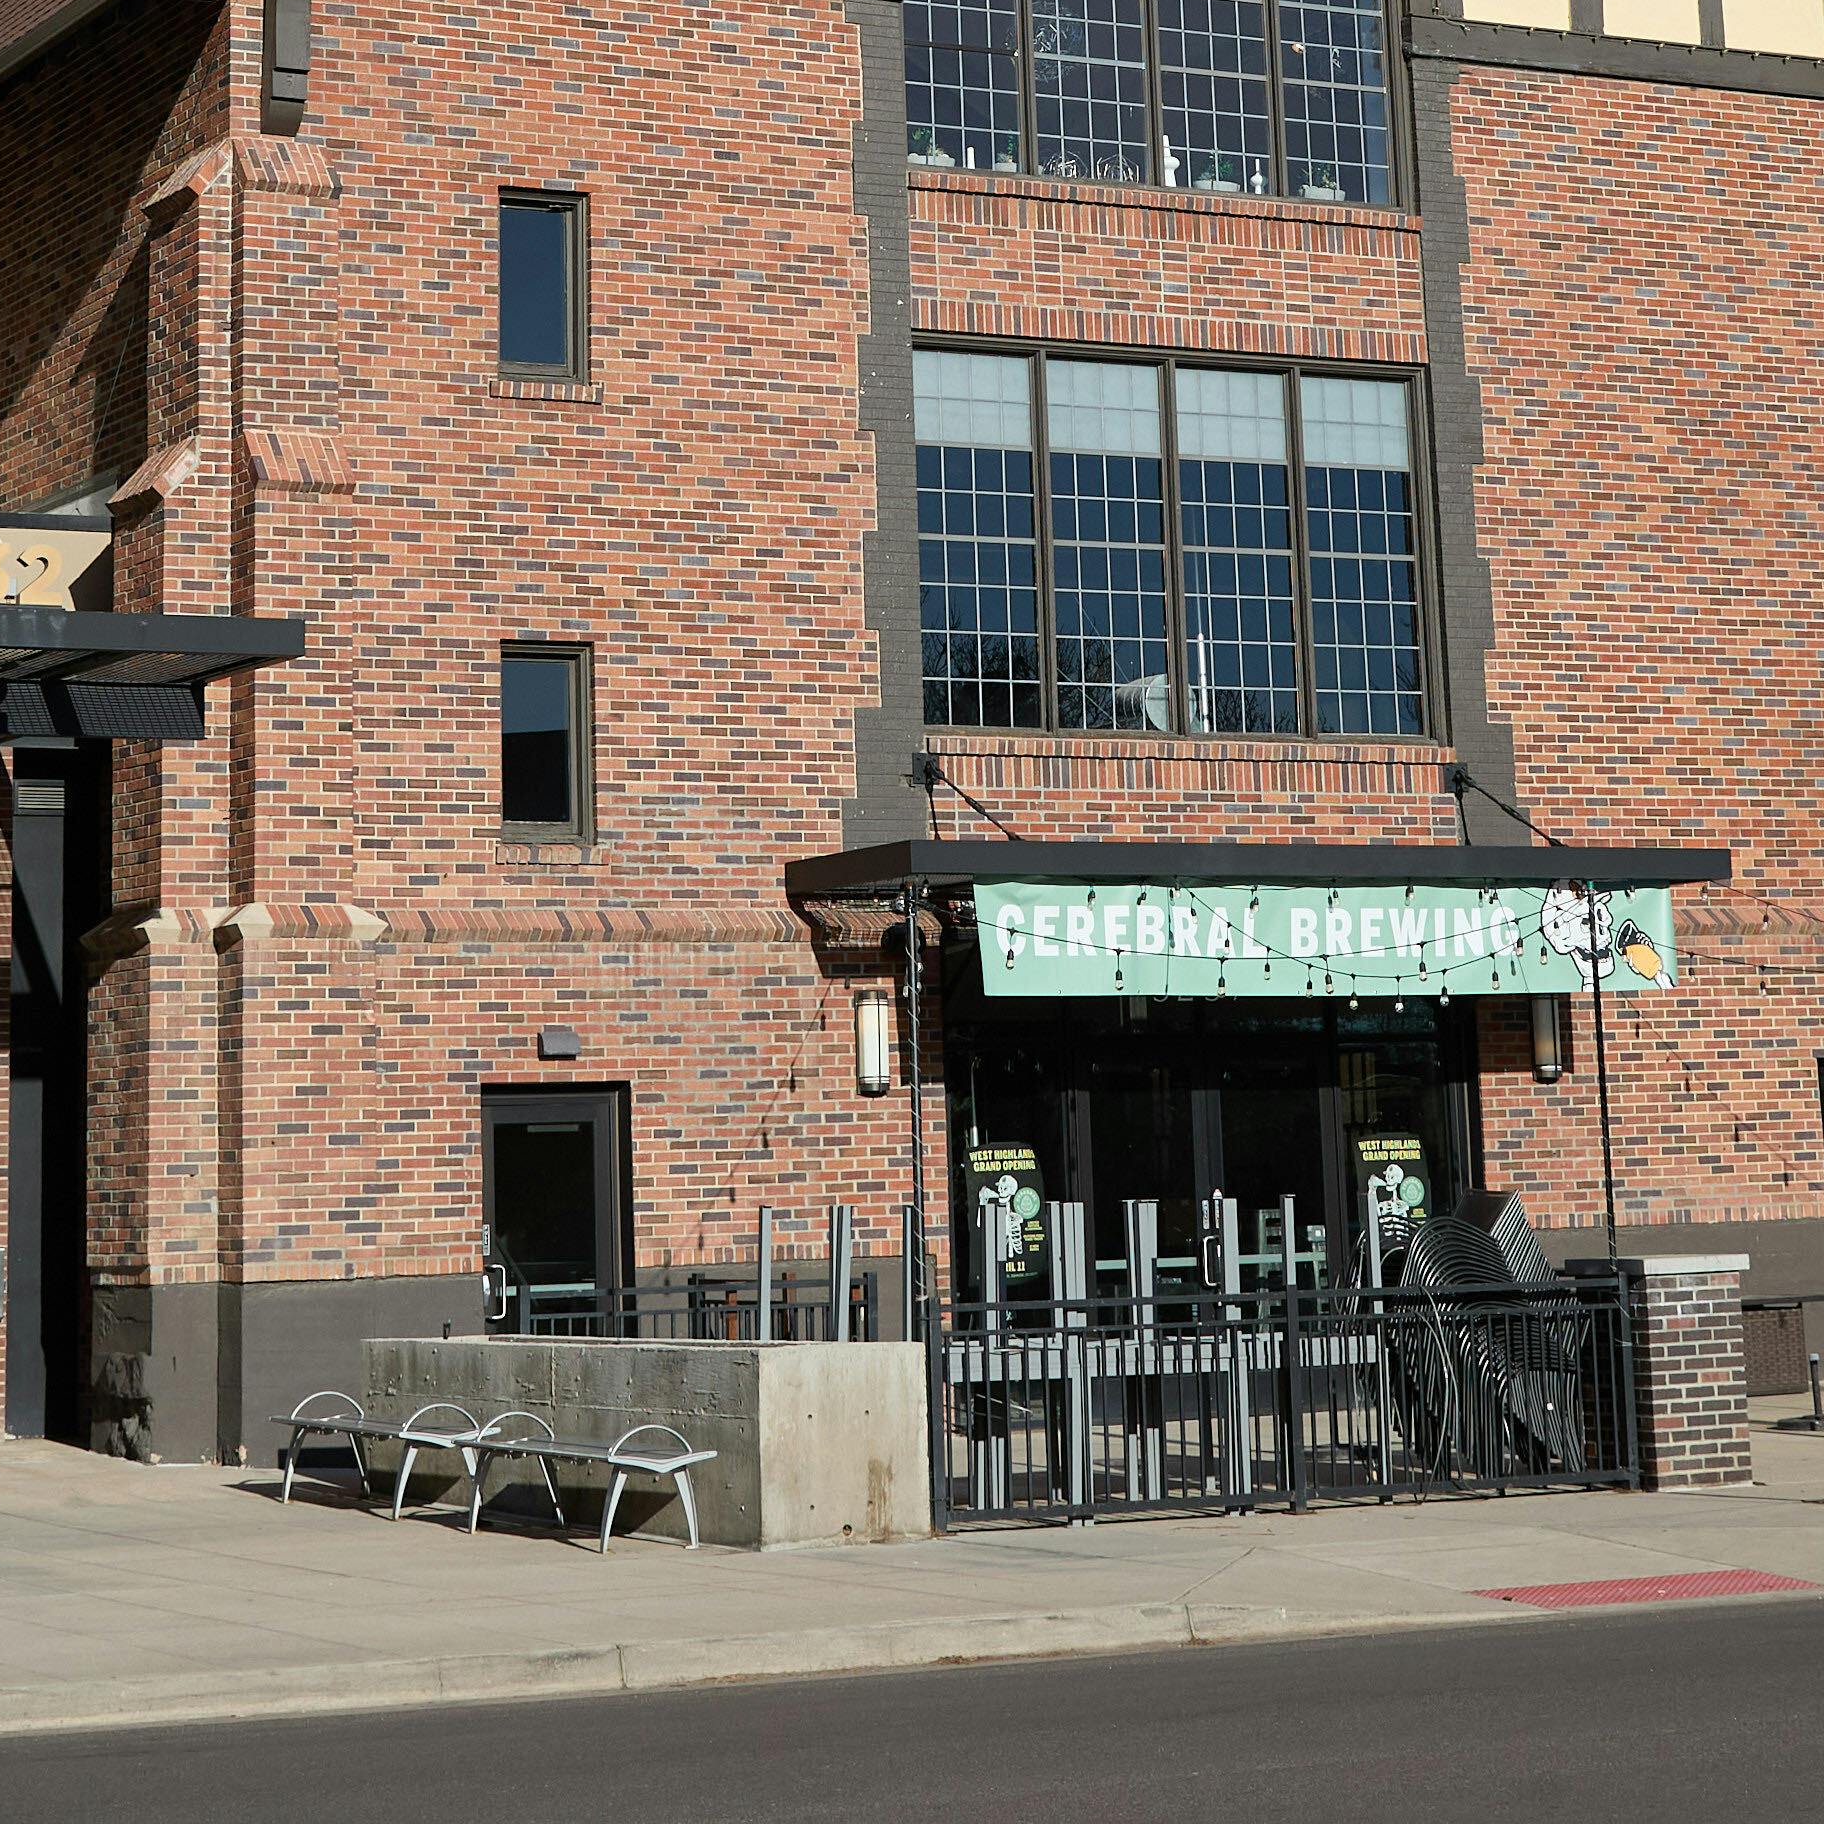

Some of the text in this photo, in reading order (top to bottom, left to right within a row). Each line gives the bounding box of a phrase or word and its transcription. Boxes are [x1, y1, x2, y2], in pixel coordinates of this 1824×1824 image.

[995, 903, 1520, 958] CEREBRAL BREWING
[1358, 1140, 1380, 1150] WEST
[969, 1150, 993, 1161] WEST
[1362, 1149, 1421, 1161] GRAND OPENING
[973, 1160, 1036, 1172] GRAND OPENING
